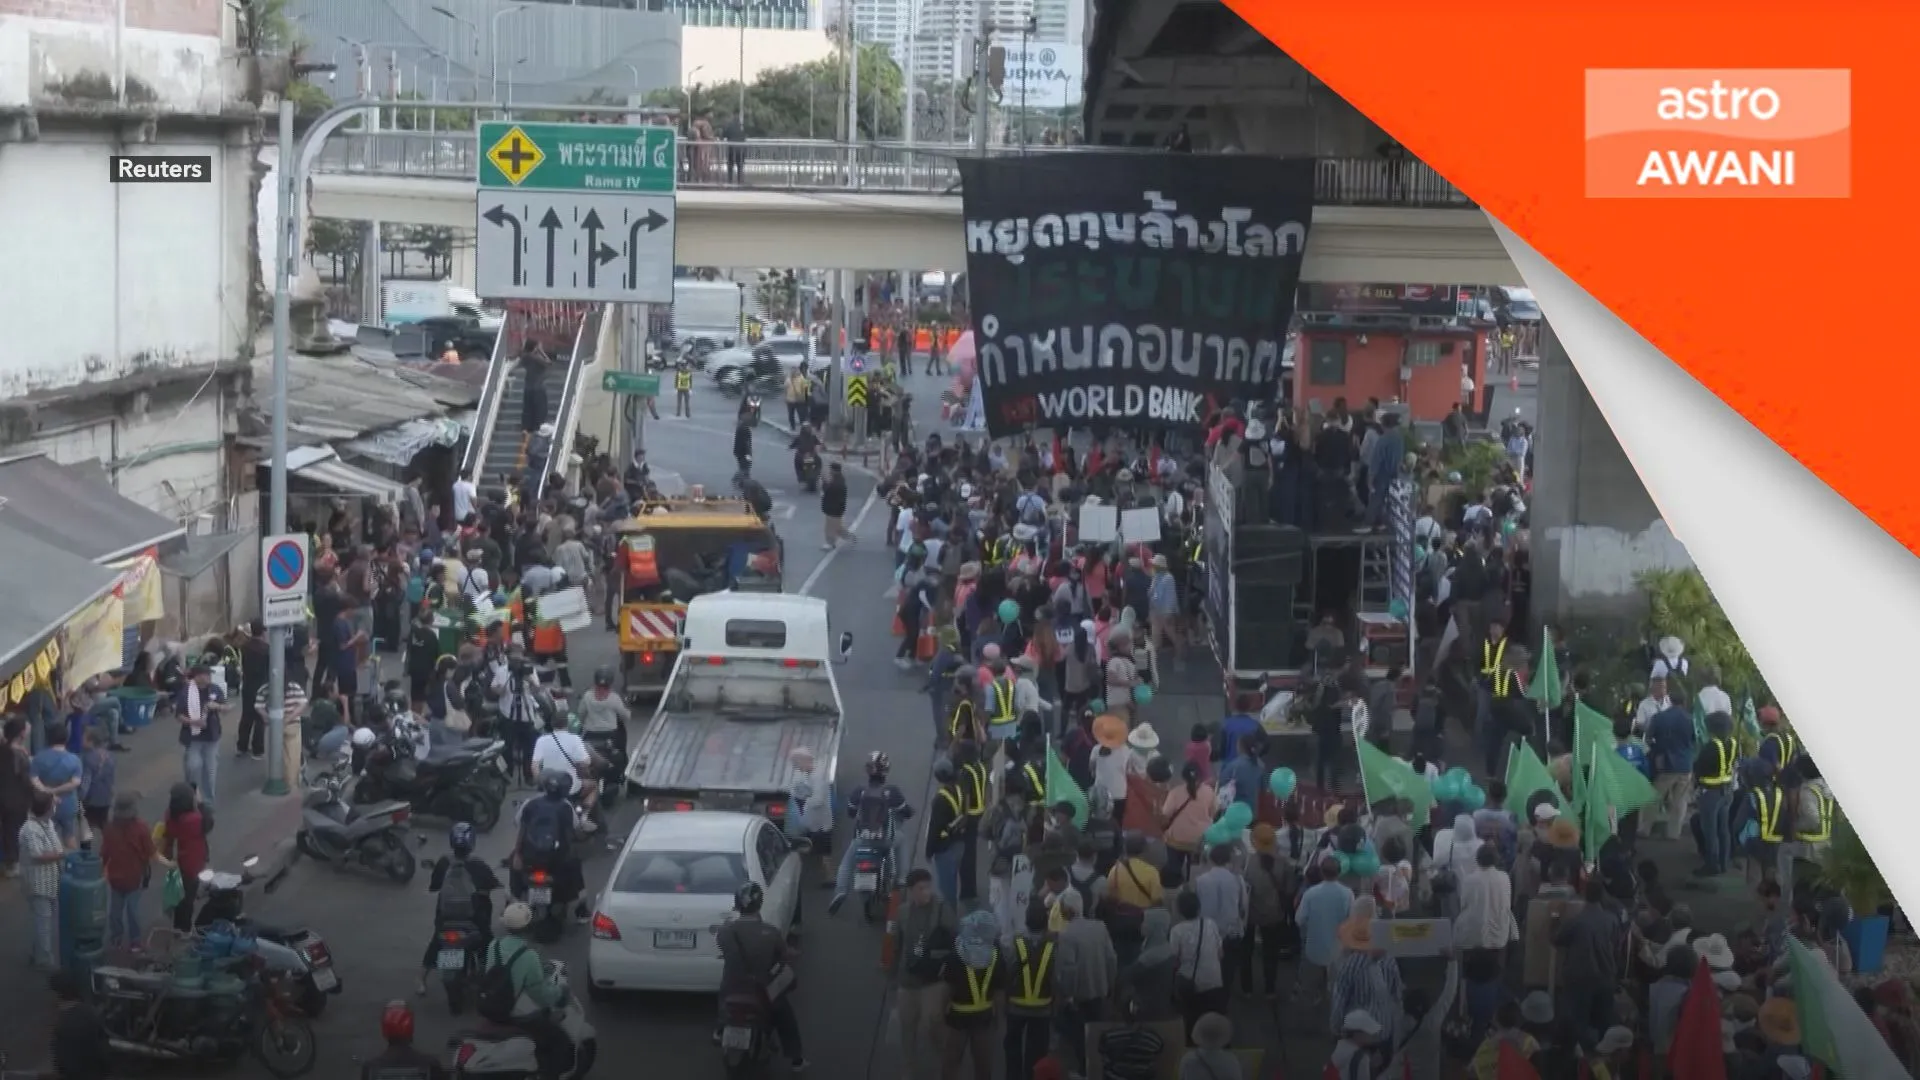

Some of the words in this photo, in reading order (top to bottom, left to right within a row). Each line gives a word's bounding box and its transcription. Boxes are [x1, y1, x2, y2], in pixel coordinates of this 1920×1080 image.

[558, 129, 647, 168] พระรามที่
[584, 174, 622, 188] Rama
[626, 175, 641, 189] IV
[1038, 384, 1145, 420] WORLD
[1149, 385, 1203, 423] BANK
